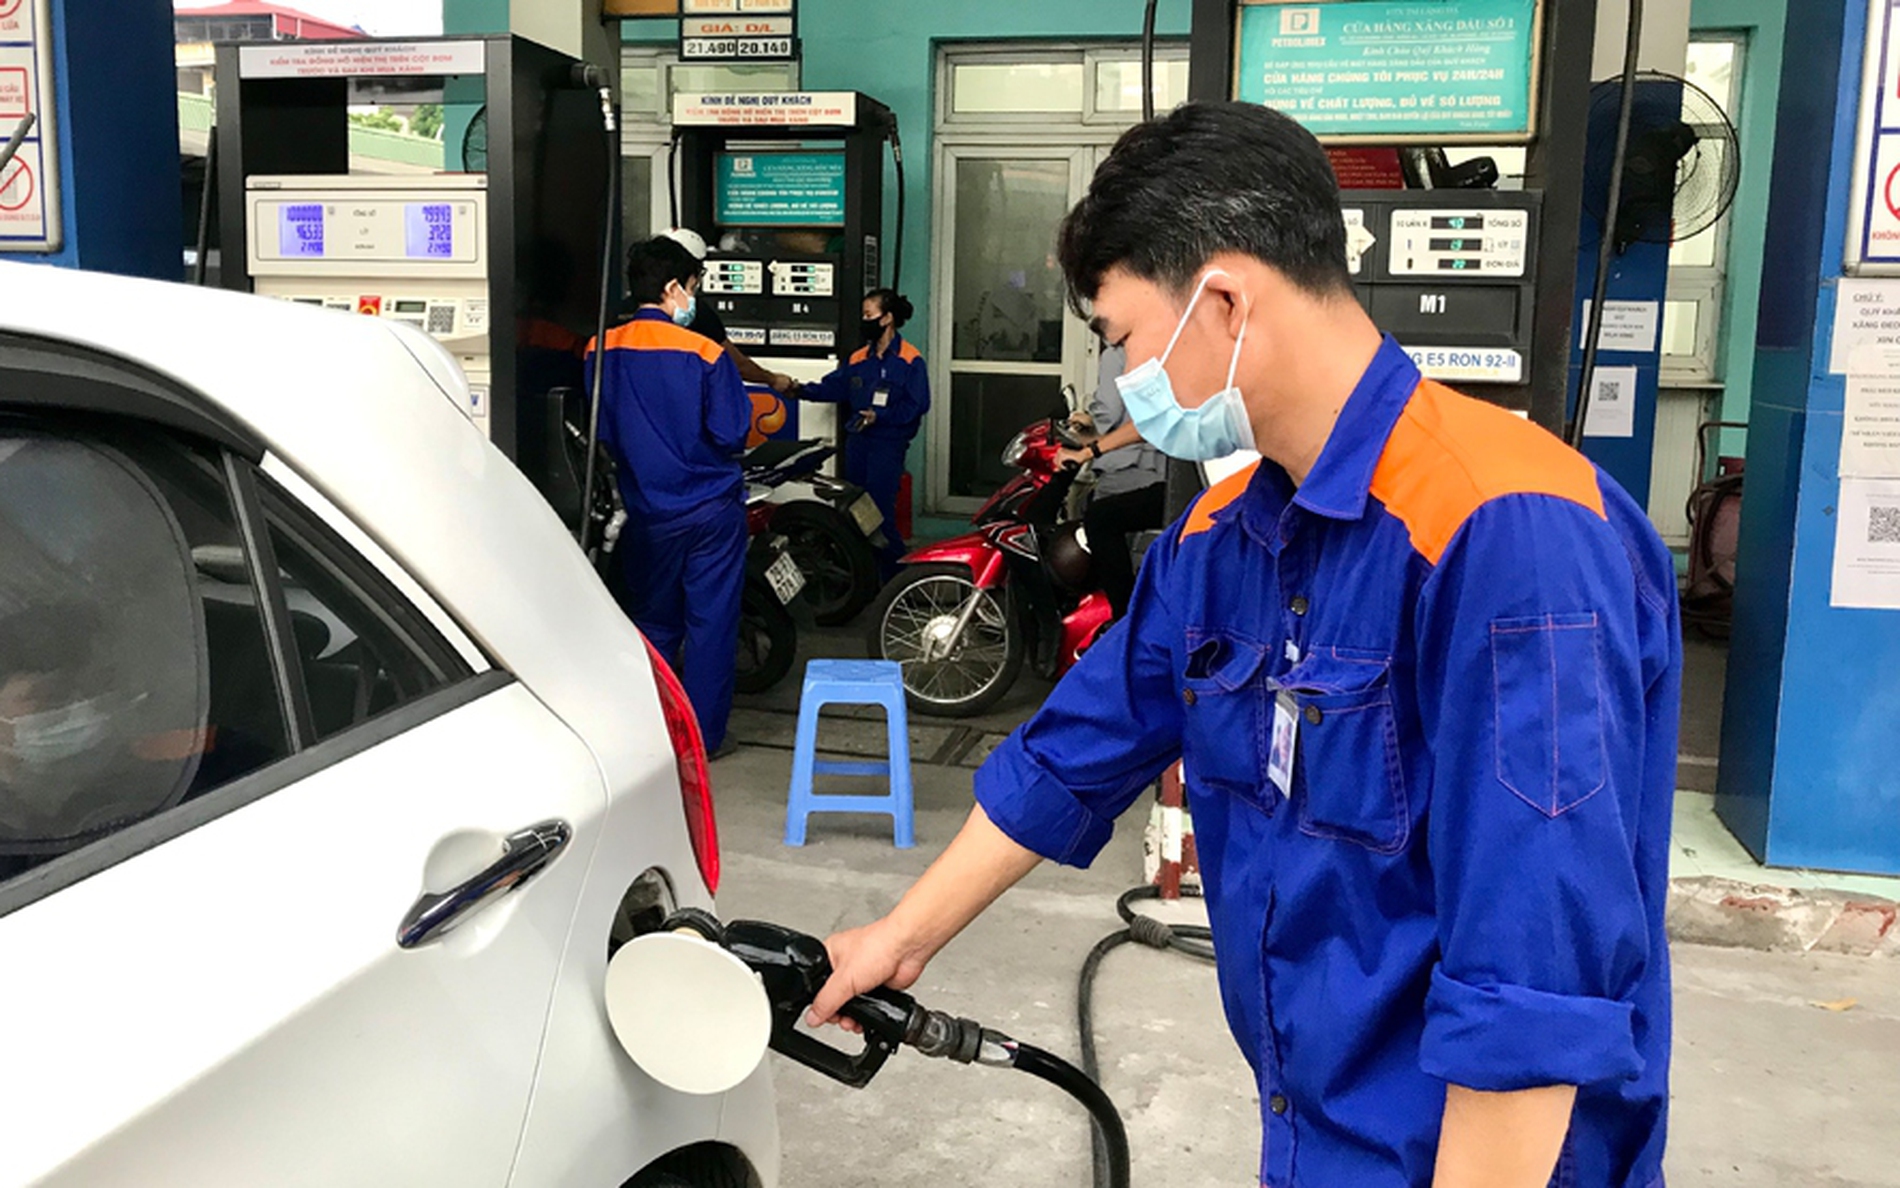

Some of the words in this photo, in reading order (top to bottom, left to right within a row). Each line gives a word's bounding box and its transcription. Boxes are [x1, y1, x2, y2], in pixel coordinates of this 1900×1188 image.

[1343, 20, 1371, 33] CỬA
[1374, 18, 1411, 33] HÀNG
[1415, 18, 1453, 32] XĂNG
[1456, 17, 1484, 31] DẦU
[1487, 16, 1505, 29] SỐ
[687, 43, 734, 53] 21.490
[740, 43, 788, 53] 20.140
[1263, 71, 1288, 84] CỬA
[1292, 71, 1325, 83] HÀNG
[1328, 70, 1370, 83] CHÚNG
[1373, 69, 1392, 82] TÔI
[1396, 71, 1429, 83] PHỤC
[1433, 70, 1448, 82] VỤ
[1452, 68, 1504, 80] 24H/24H
[1300, 97, 1316, 109] VỀ
[1318, 97, 1349, 109] CHẤT
[1353, 97, 1397, 110] LƯỢNG,
[1400, 94, 1417, 107] ĐỦ
[1420, 94, 1436, 107] VỀ
[1440, 94, 1457, 107] SỐ
[1460, 95, 1502, 108] LƯỢNG
[1419, 294, 1447, 314] M1
[1427, 353, 1445, 366] E5
[1448, 354, 1481, 367] RON
[1485, 354, 1517, 368] 92-II
